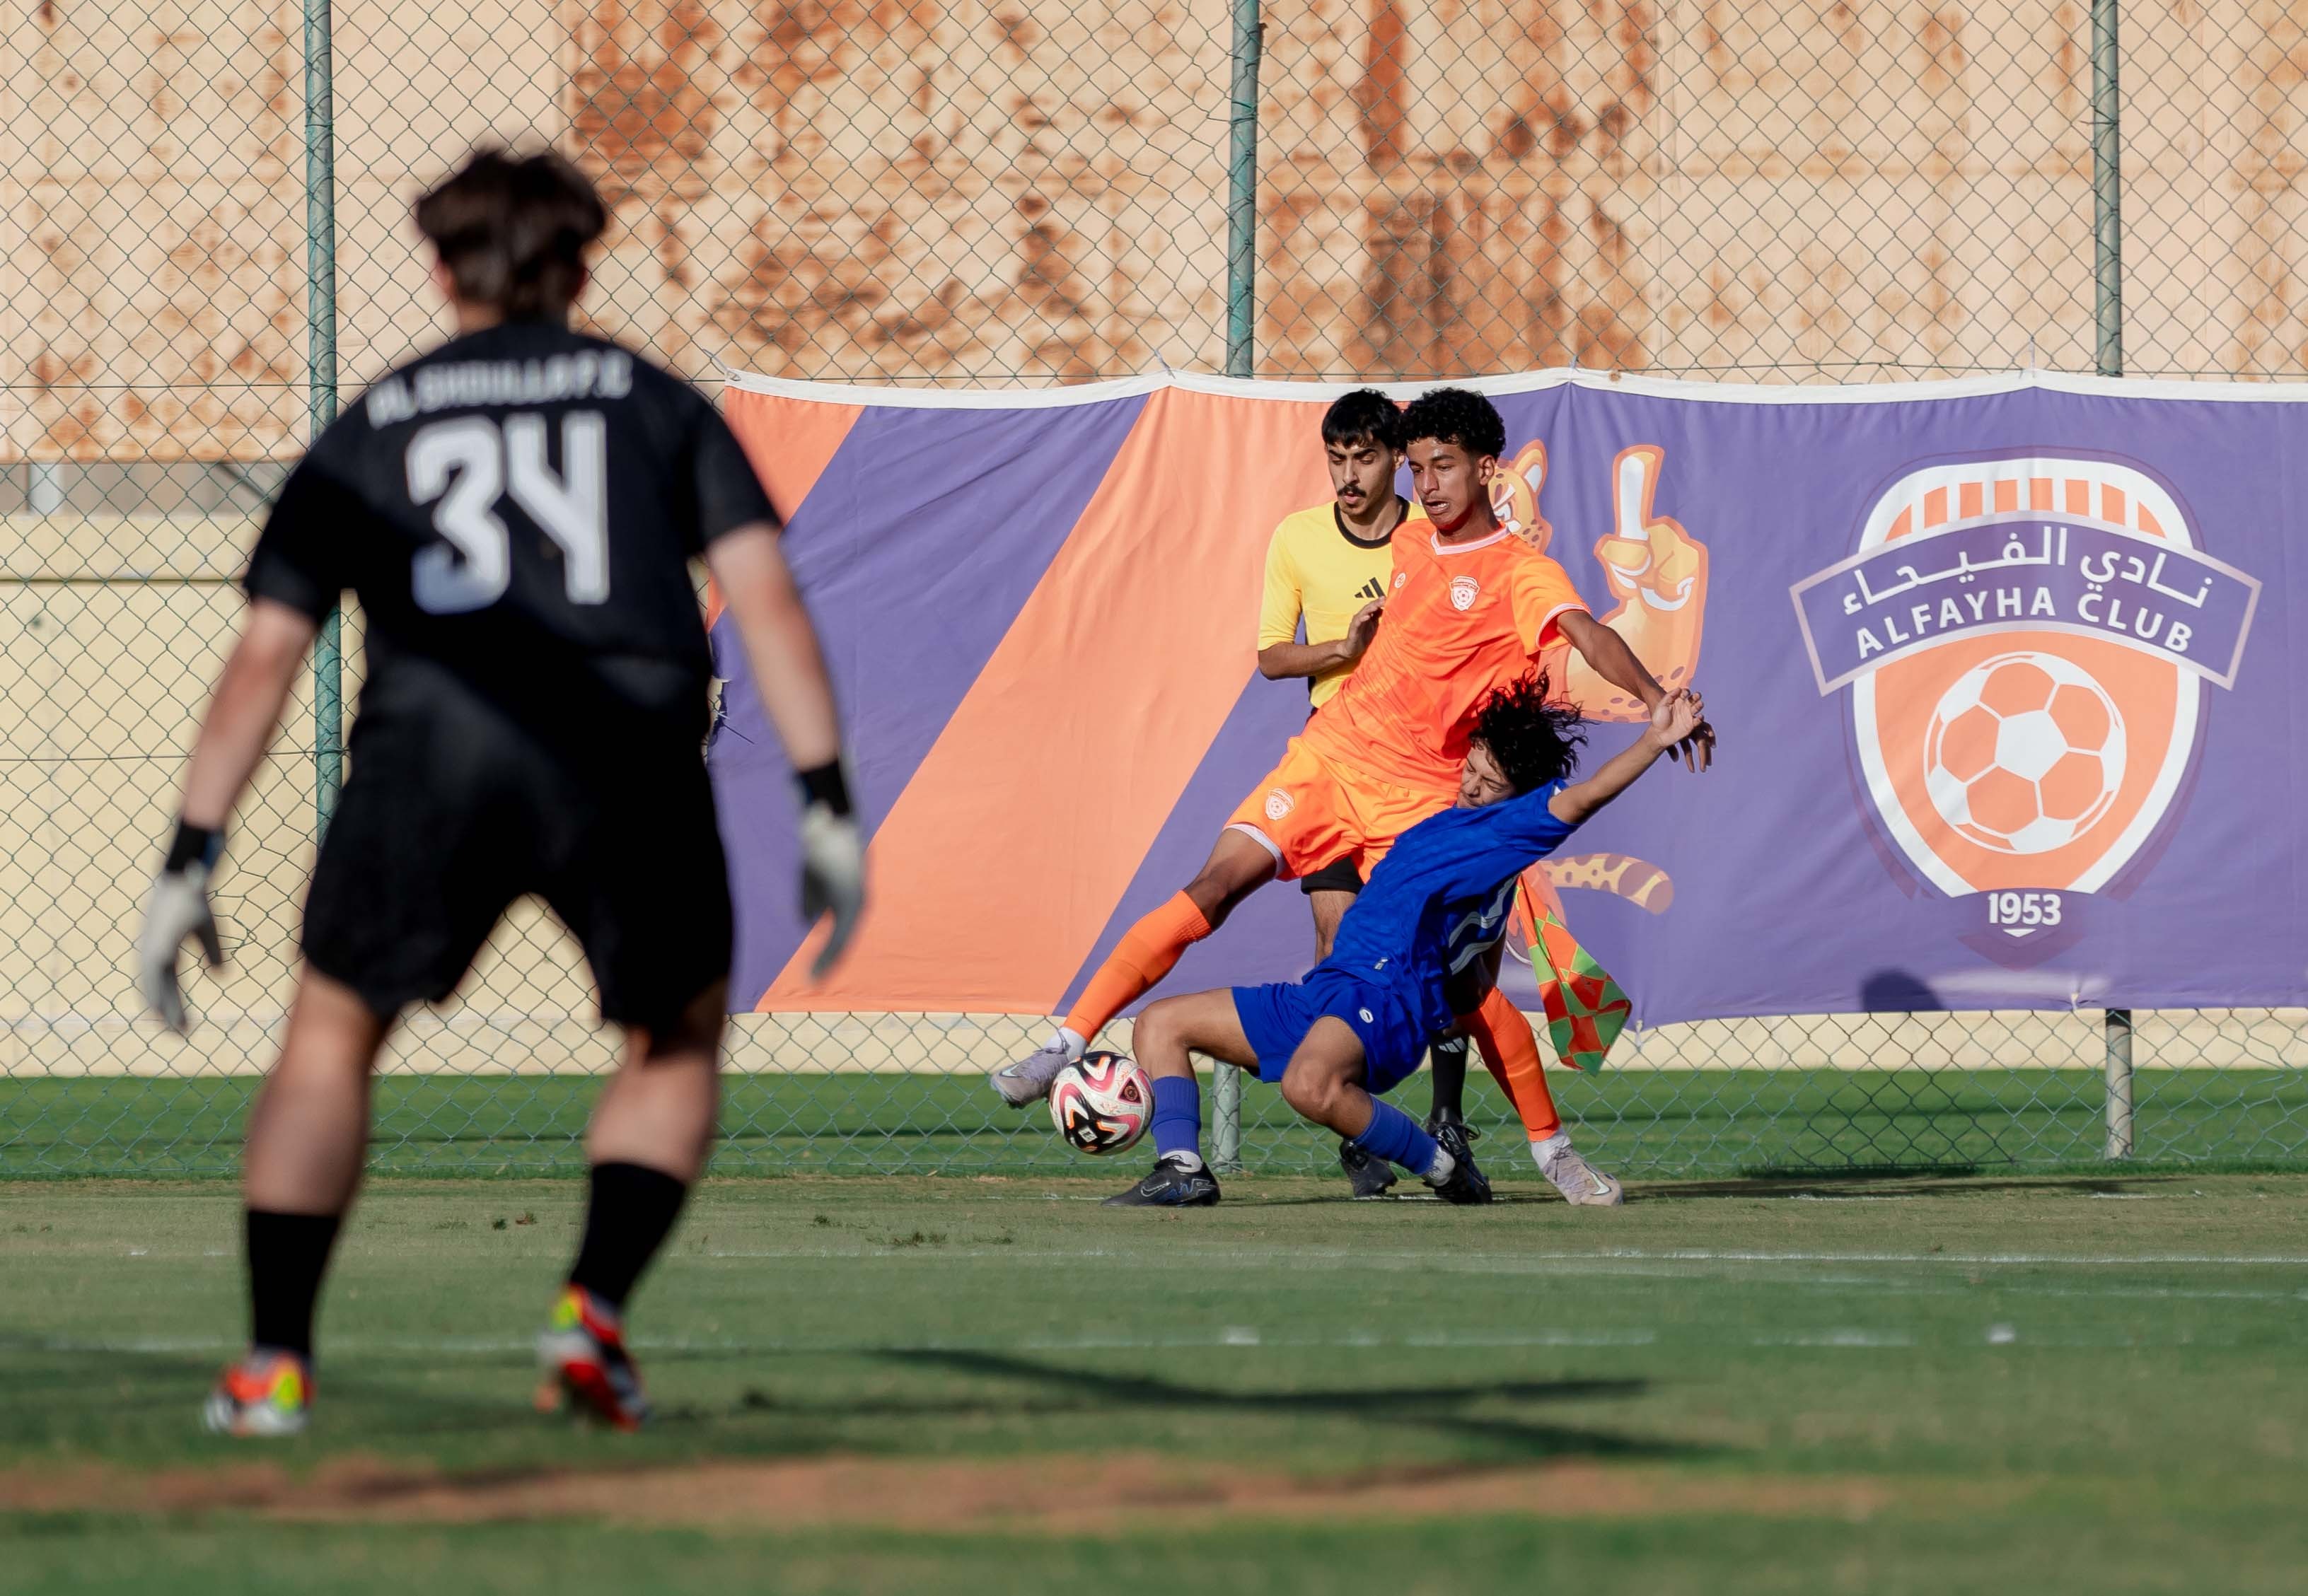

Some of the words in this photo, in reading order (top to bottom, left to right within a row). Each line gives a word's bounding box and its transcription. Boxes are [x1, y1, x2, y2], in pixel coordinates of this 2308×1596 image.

[406, 410, 610, 614] 34
[1843, 526, 2068, 614] الفيحاء
[2080, 552, 2213, 607] نادي
[1857, 587, 2055, 658] ALFAYHA
[2077, 593, 2193, 653] CLUB
[1988, 893, 2061, 926] 1953
